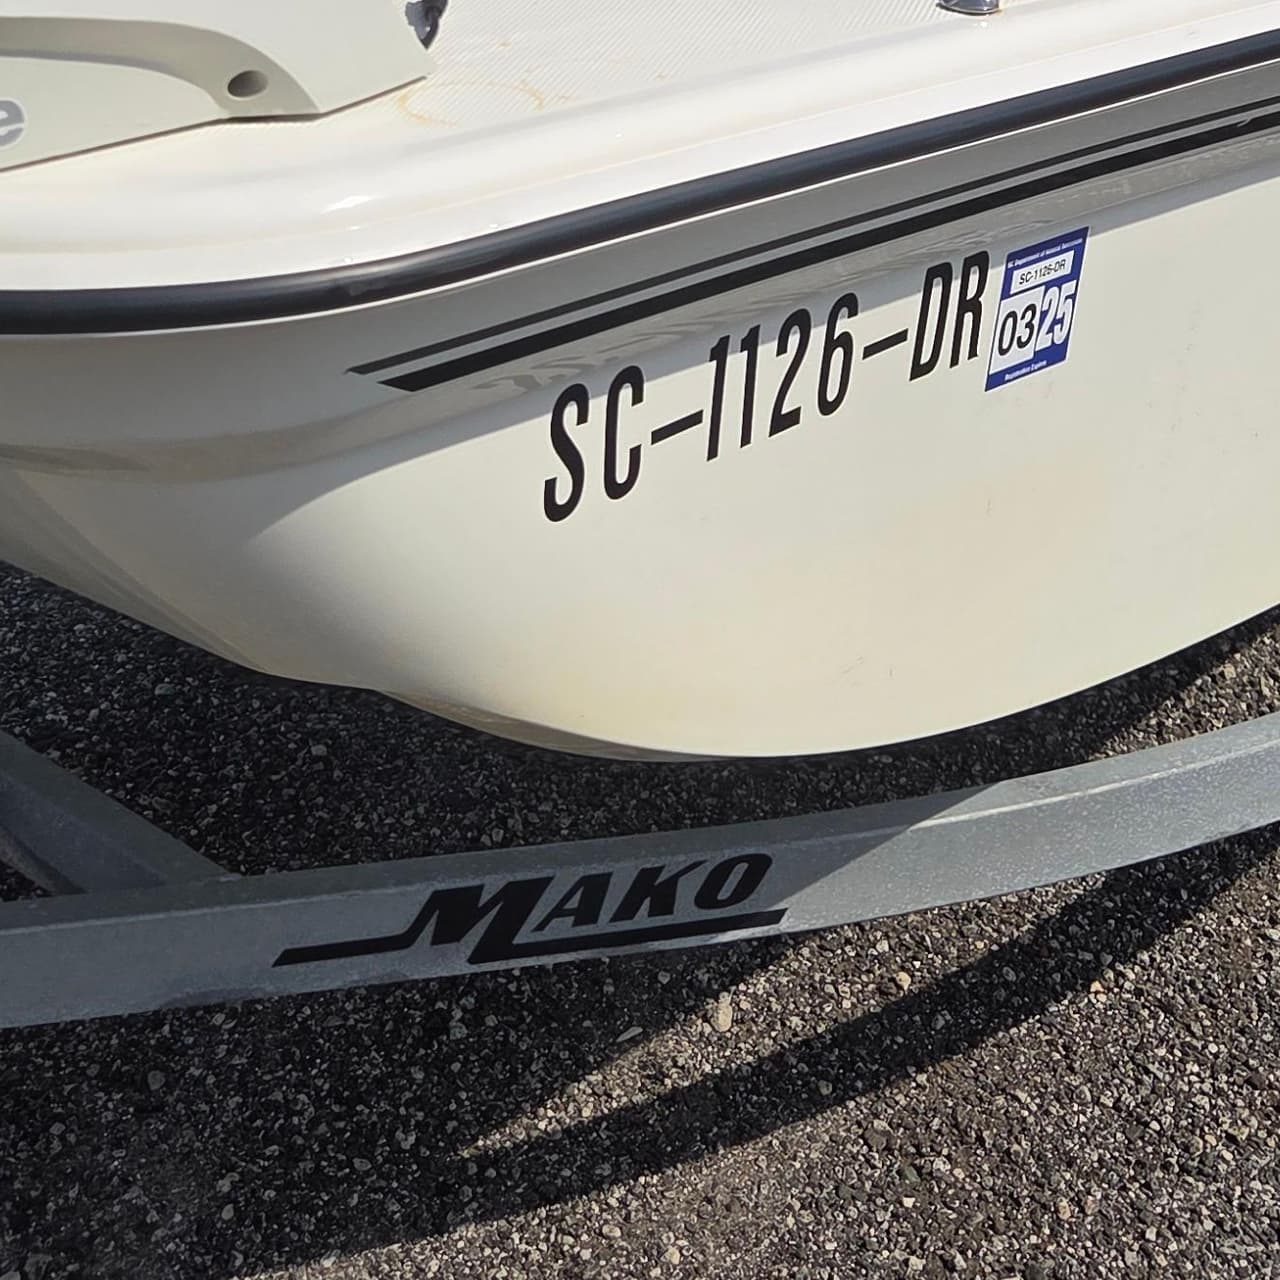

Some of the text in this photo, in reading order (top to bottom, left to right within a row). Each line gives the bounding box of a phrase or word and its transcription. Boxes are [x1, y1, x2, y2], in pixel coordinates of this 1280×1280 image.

[997, 279, 1077, 357] 03 25
[543, 250, 990, 522] SC-1126-DR
[272, 853, 788, 968] MAKO
